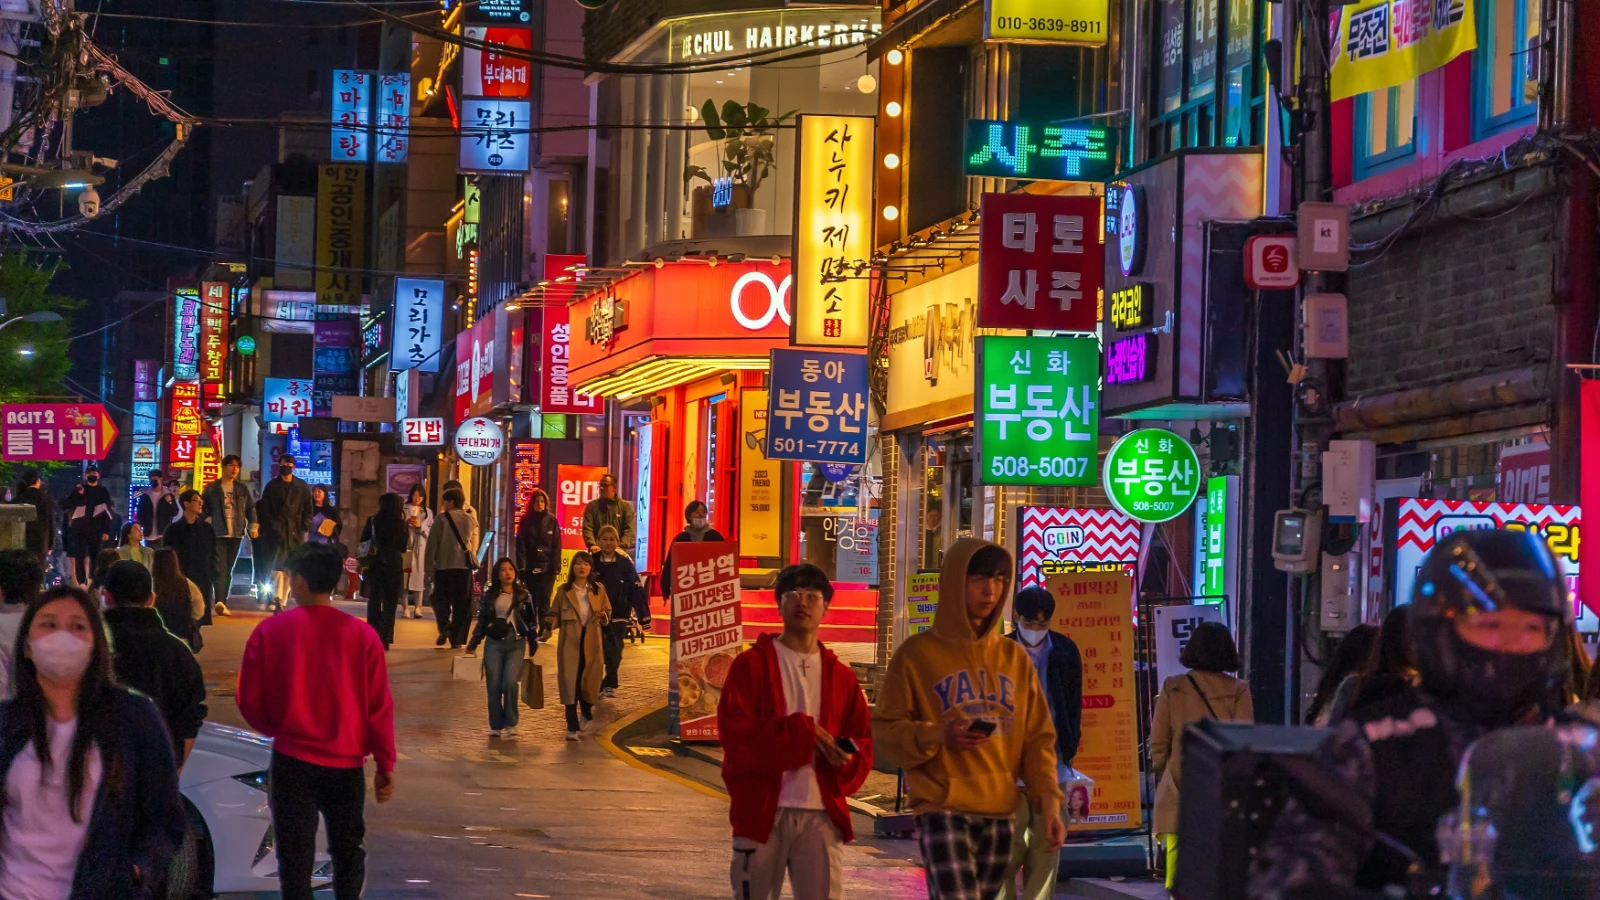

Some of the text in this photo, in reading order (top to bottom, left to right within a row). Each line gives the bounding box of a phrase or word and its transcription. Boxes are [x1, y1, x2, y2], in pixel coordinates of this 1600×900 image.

[997, 16, 1101, 34] 010-3639-8911
[1347, 2, 1390, 63] 무조건
[484, 65, 527, 84] 부대찌개
[339, 87, 361, 157] 마라탕
[476, 108, 515, 127] 모리
[970, 124, 1107, 176] 사주
[1002, 212, 1084, 253] 타로
[1320, 227, 1332, 238] kt
[1000, 269, 1083, 311] 사주
[801, 359, 846, 384] 동아
[1010, 350, 1072, 376] 신화
[7, 411, 42, 424] AGIT
[45, 409, 55, 424] 2
[774, 388, 866, 433] 부동산
[985, 384, 1095, 441] 부동산
[8, 429, 97, 455] 룸카페
[405, 420, 442, 443] 김밥
[457, 437, 501, 448] 부대찌개
[774, 438, 860, 456] 501-7774
[1135, 438, 1174, 454] 신화
[991, 456, 1089, 477] 508-5007
[1114, 459, 1193, 496] 부동산
[1133, 501, 1175, 511] 508-5007
[1047, 530, 1080, 545] COIN
[676, 553, 735, 589] 강남역
[679, 582, 736, 612] 피자맛집
[912, 583, 939, 592] OPEN
[679, 606, 736, 637] 오리지널
[680, 628, 739, 657] 시카고피자
[934, 668, 1015, 714] YALE
